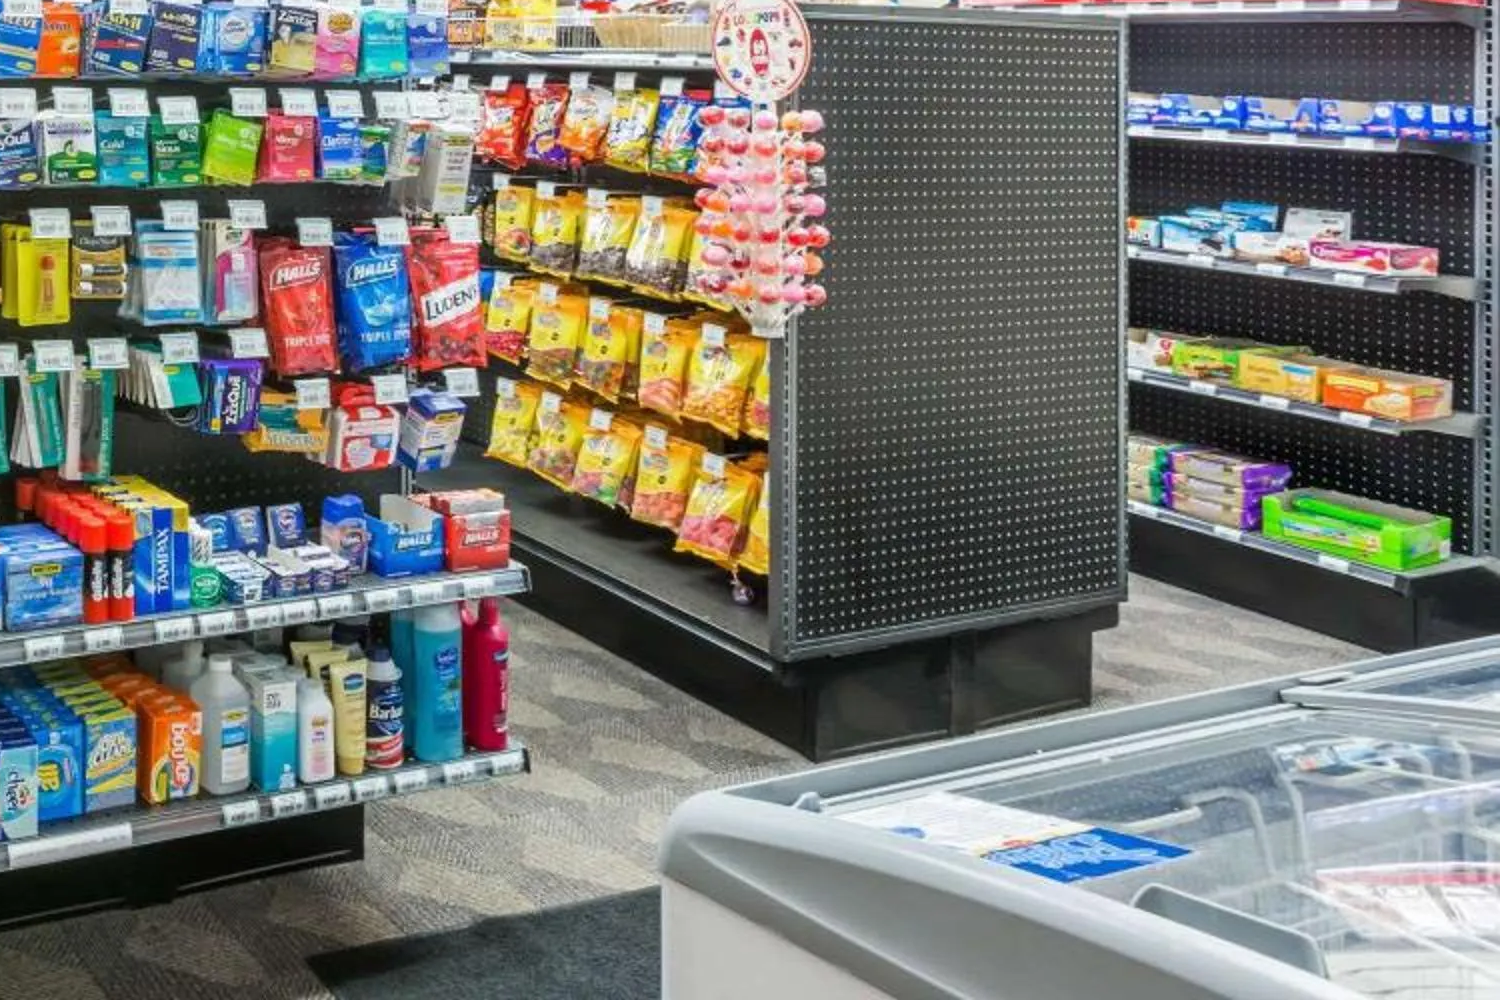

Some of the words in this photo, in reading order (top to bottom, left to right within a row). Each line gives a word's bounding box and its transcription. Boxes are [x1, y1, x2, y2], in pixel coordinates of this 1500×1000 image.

[277, 261, 321, 283] HALLS
[352, 260, 398, 280] HALLS
[465, 530, 498, 545] HALLS
[157, 528, 169, 594] TAMPAX
